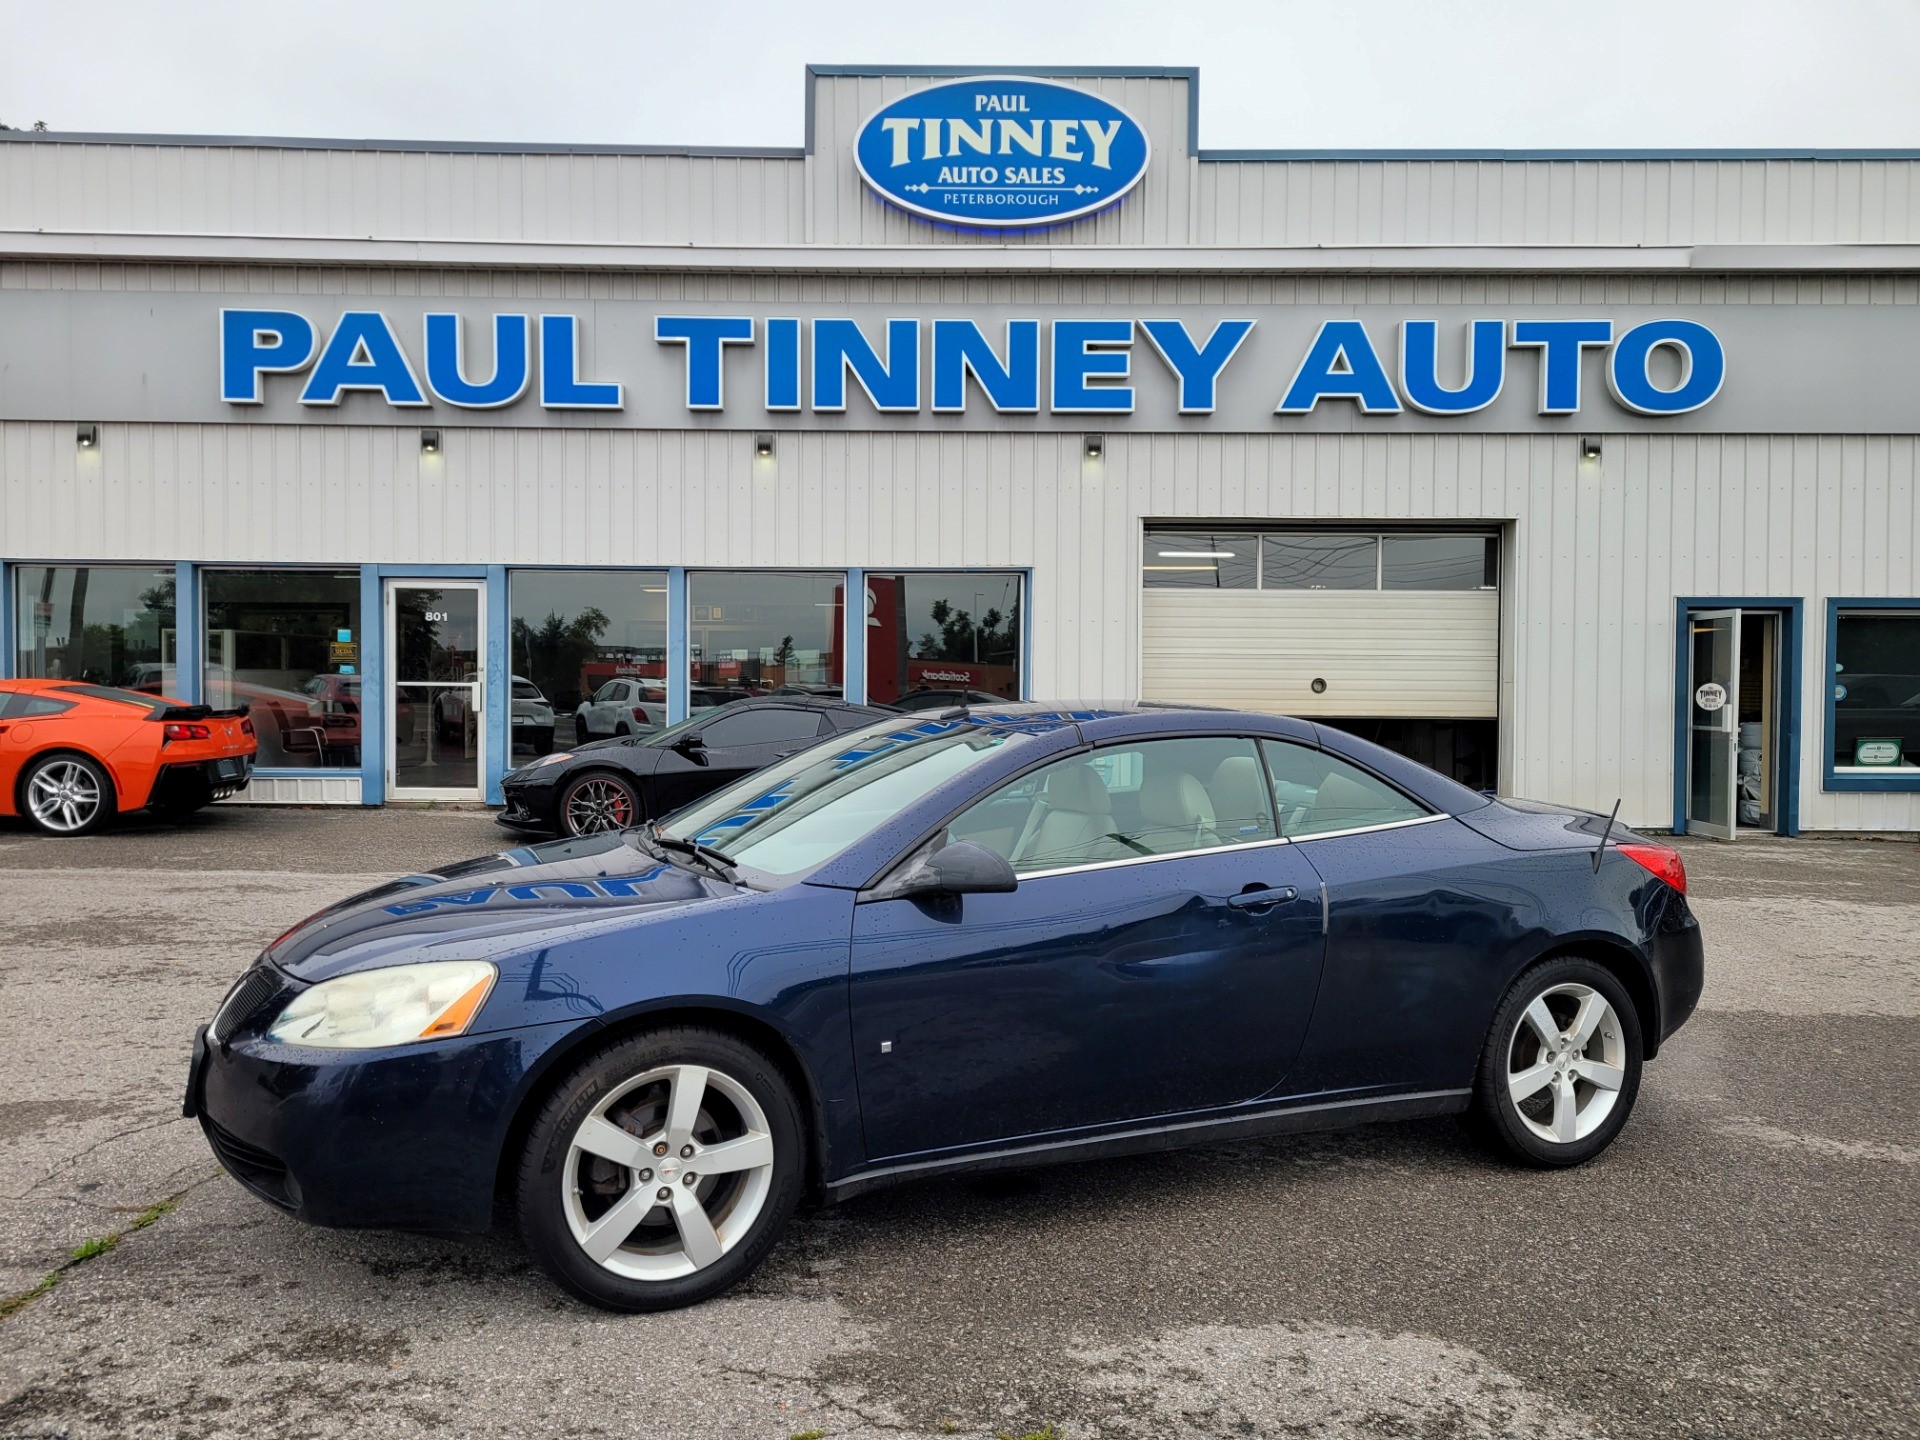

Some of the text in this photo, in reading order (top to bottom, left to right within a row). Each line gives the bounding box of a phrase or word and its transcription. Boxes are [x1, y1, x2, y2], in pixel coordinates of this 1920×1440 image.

[975, 94, 1030, 112] PAUL
[881, 118, 1123, 170] TINNEY
[938, 167, 1066, 185] AUTO SALES
[944, 194, 1059, 205] PETERBOROUGH
[220, 308, 1727, 416] PAUL TINNEY AUTO
[425, 612, 448, 622] 801
[1700, 690, 1722, 699] TINNEY
